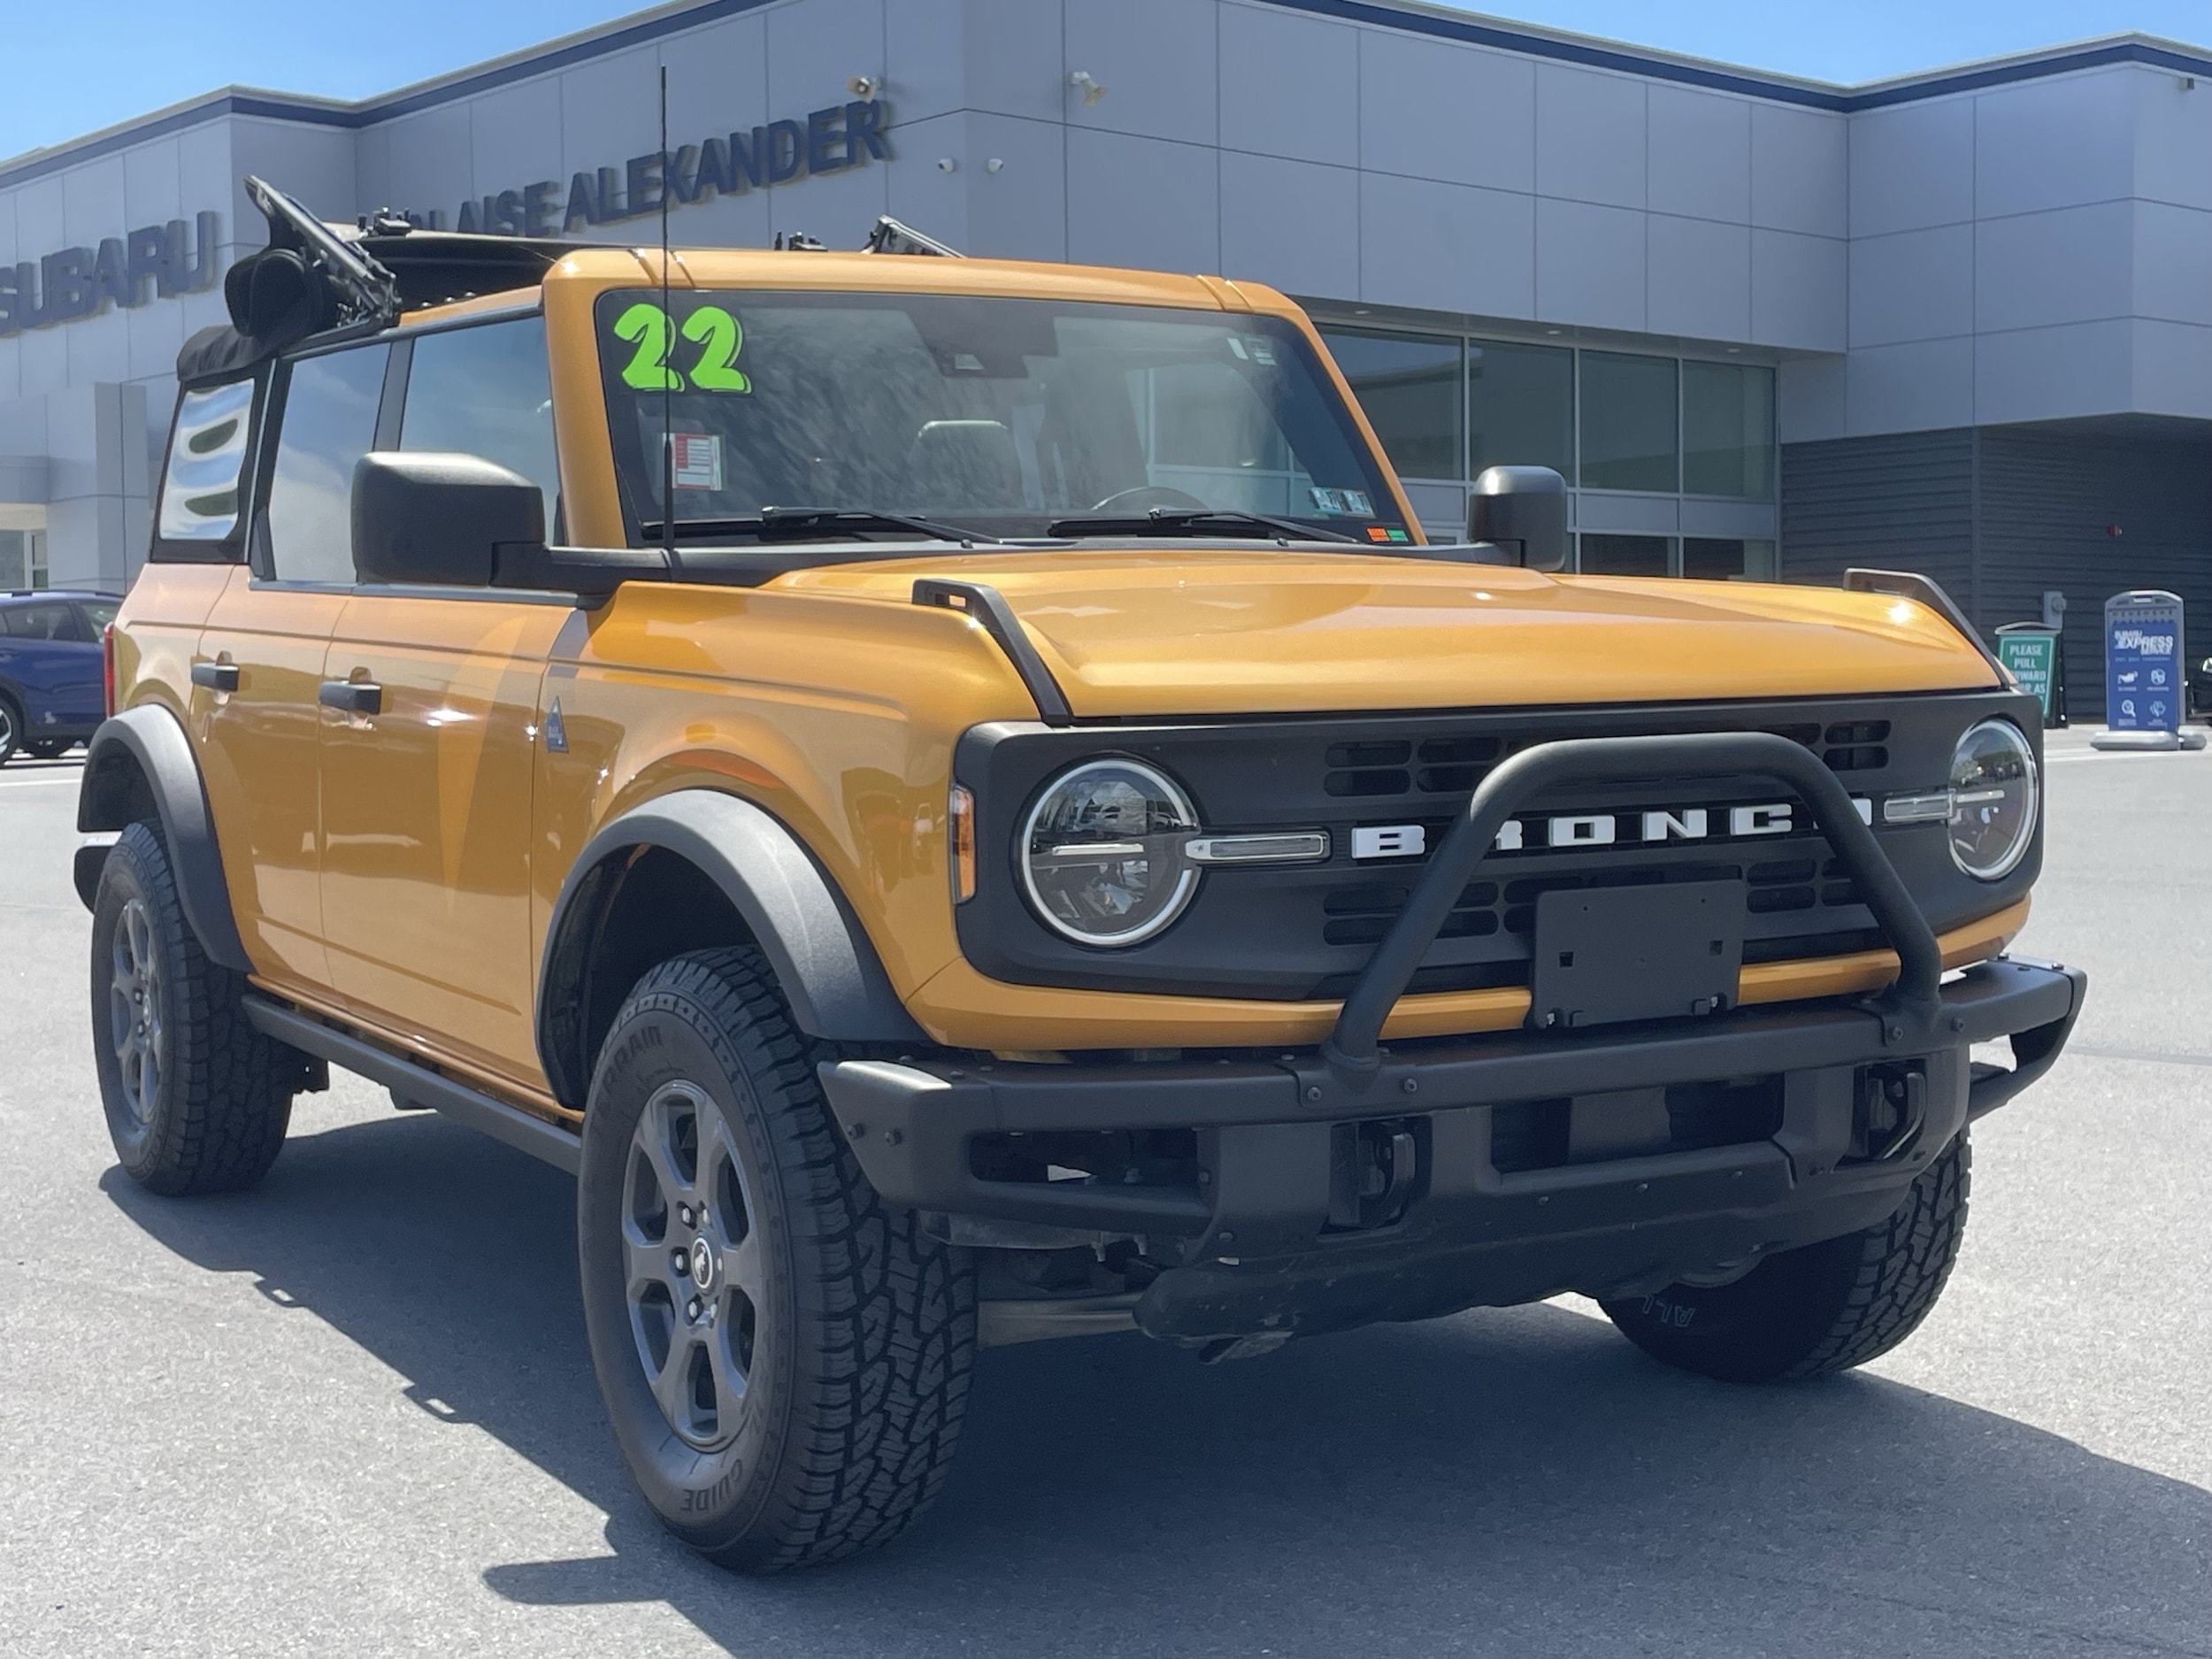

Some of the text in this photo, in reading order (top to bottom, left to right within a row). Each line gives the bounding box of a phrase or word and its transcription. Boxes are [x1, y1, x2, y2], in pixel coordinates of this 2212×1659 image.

[410, 98, 889, 237] AISE ALEXANDER
[0, 210, 217, 337] SUBARU
[613, 303, 752, 394] 22
[2009, 644, 2043, 657] PLEASE
[2012, 670, 2047, 681] RWARD
[2014, 657, 2037, 669] PULL
